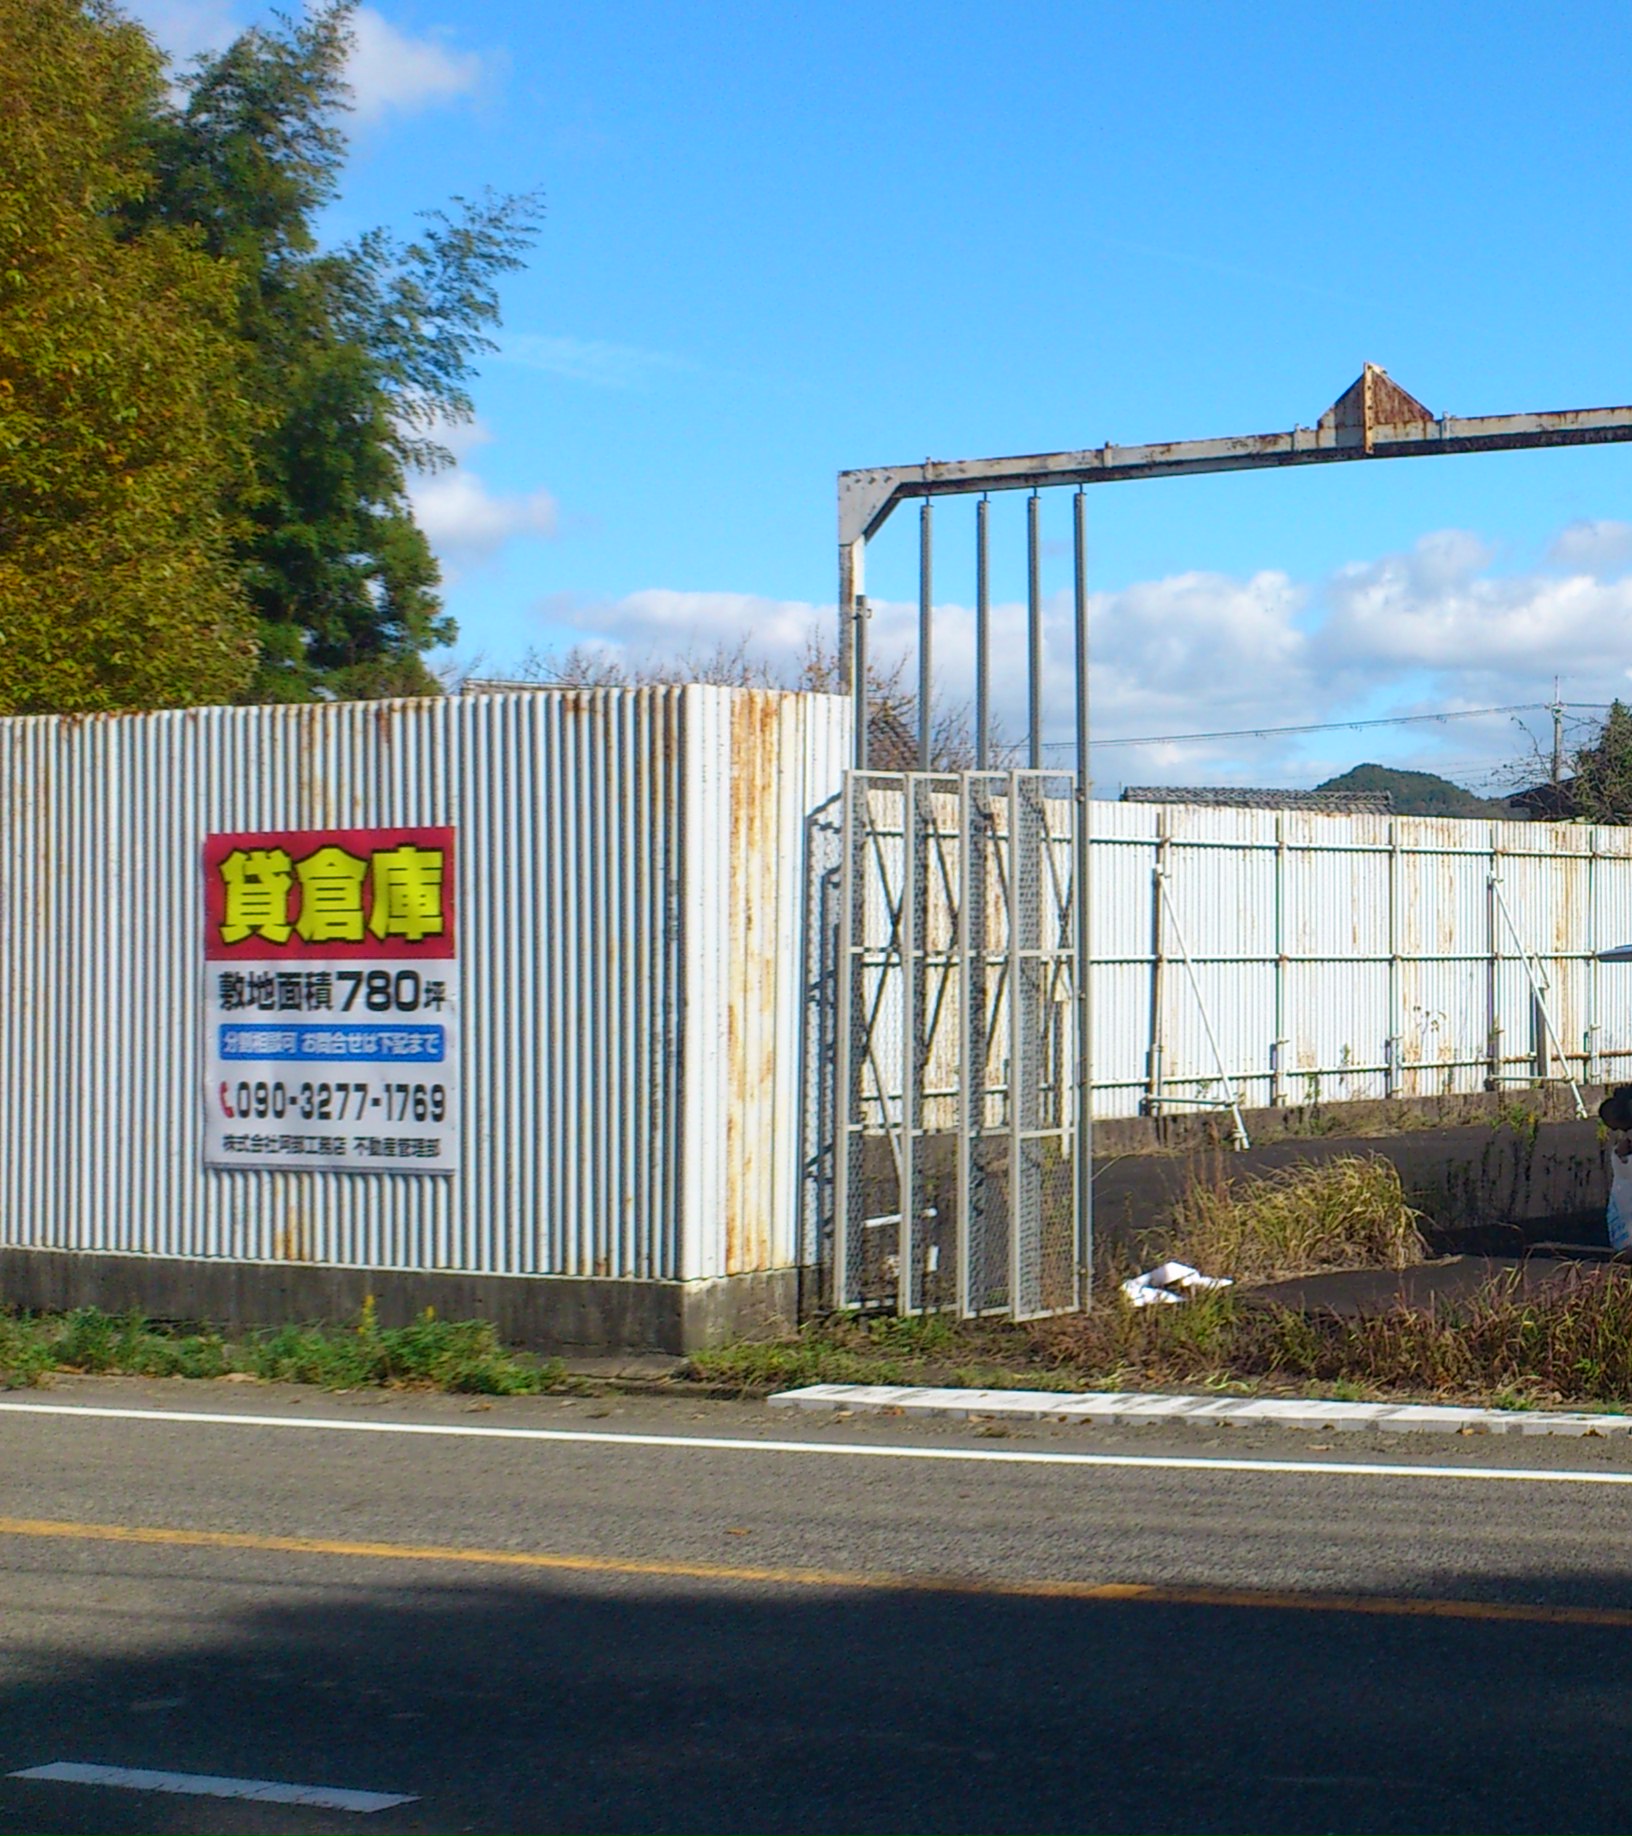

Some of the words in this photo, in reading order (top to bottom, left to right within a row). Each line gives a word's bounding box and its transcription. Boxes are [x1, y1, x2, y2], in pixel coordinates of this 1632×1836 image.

[218, 843, 445, 946] 貸倉庫
[237, 1081, 446, 1122] 090-3277-1769
